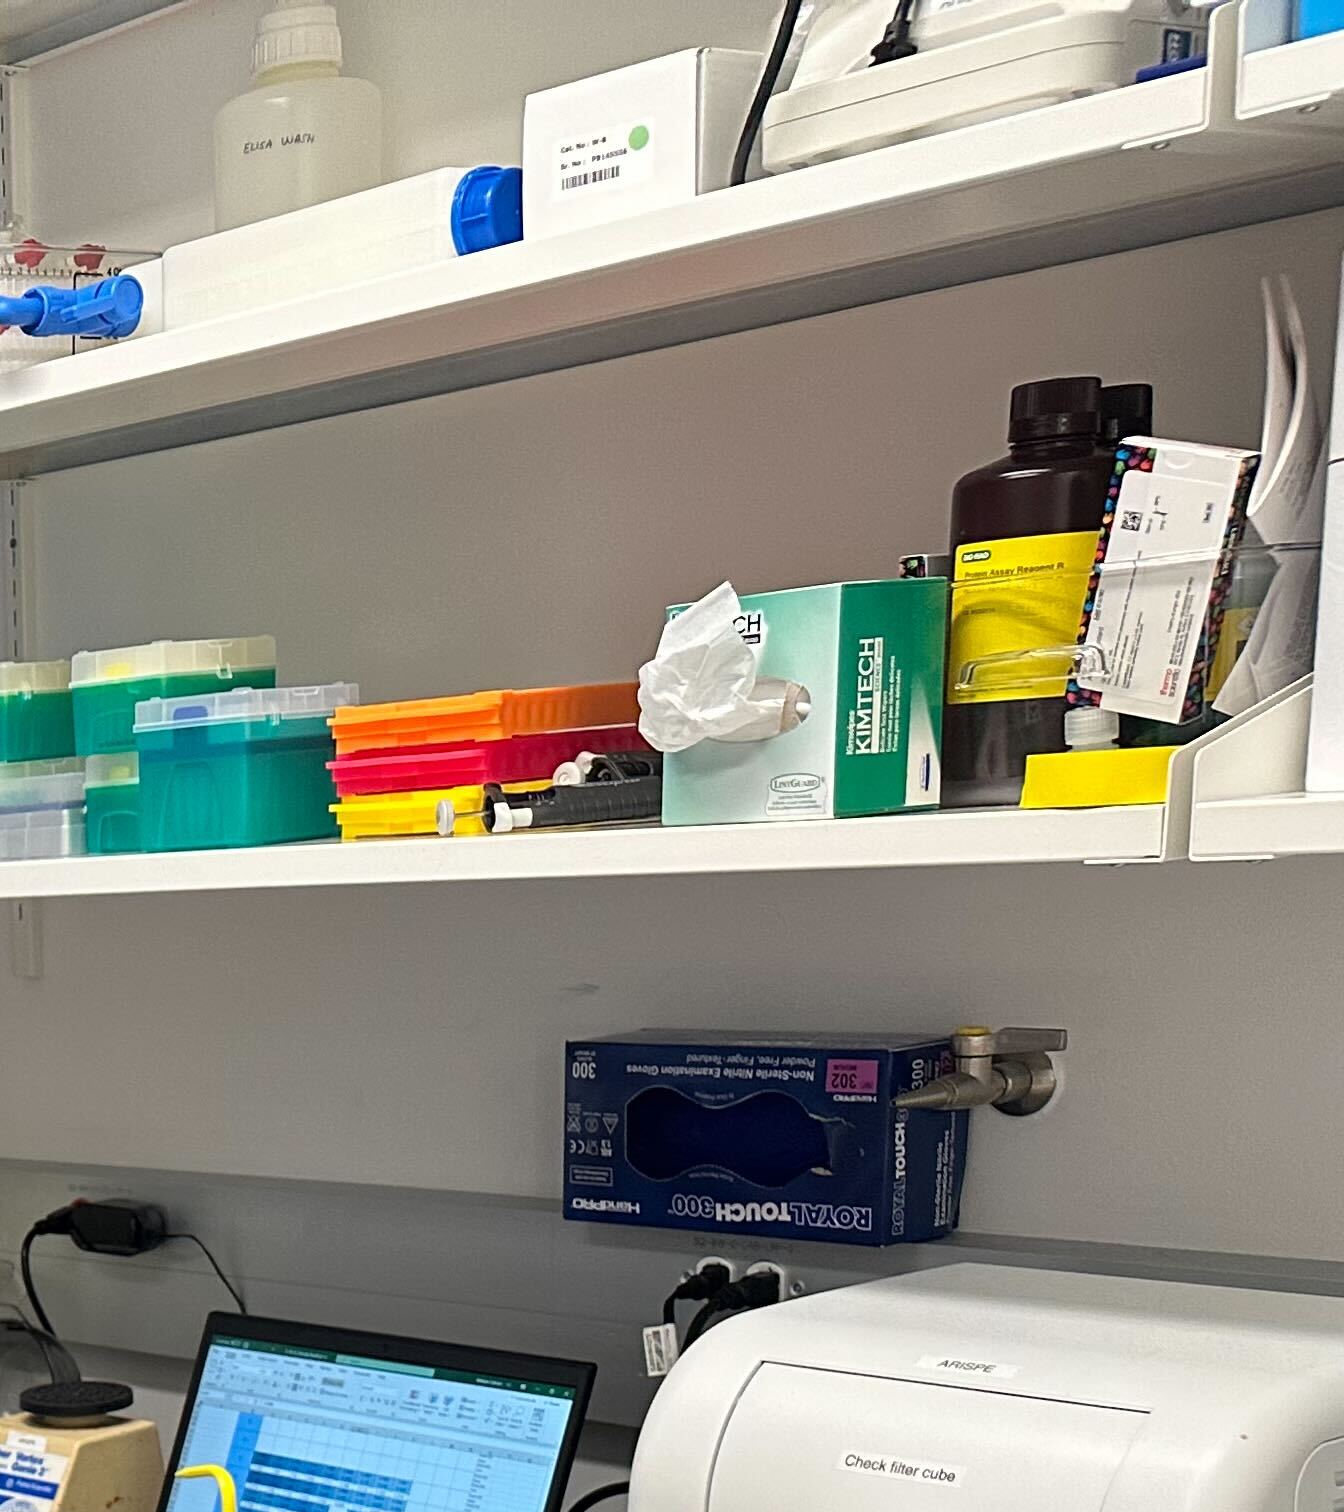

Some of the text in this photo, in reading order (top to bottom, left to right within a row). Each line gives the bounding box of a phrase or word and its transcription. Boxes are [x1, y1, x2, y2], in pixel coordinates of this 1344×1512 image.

[243, 139, 272, 154] ELISA
[990, 566, 1015, 578] Assay
[855, 638, 874, 755] KIMTECH
[571, 1061, 597, 1079] 300
[781, 1056, 816, 1067] Powder
[625, 1063, 815, 1081] Non-Sterile Nitrile Examination Gloves
[831, 1073, 857, 1089] 302
[936, 1358, 998, 1375] ARISPE
[844, 1453, 957, 1484] Check filter cube
